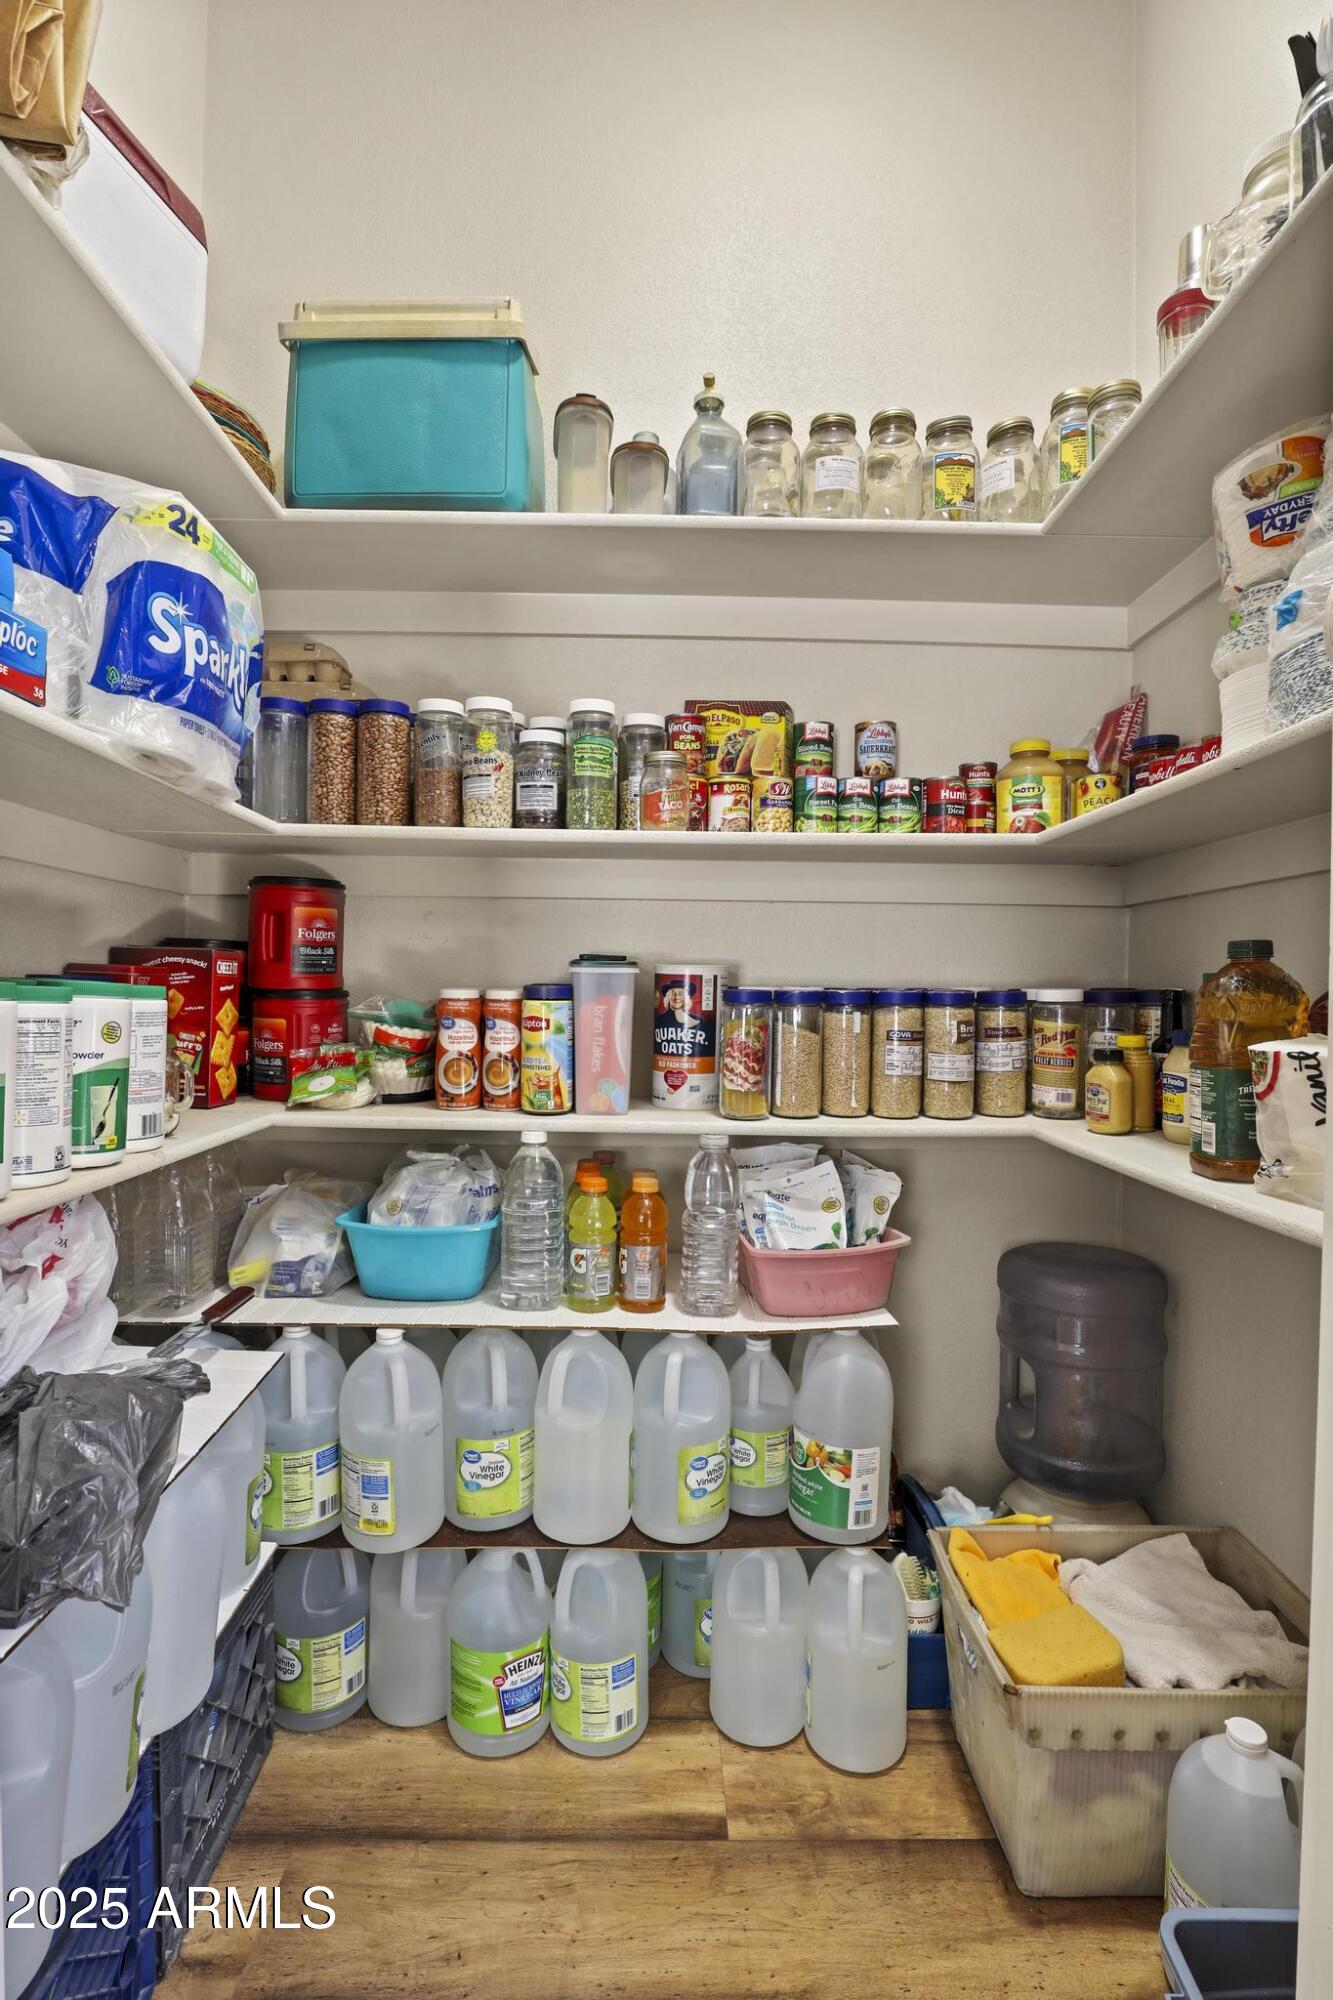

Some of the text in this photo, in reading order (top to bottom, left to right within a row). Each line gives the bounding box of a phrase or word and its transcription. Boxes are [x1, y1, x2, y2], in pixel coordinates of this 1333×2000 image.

[1263, 494, 1313, 519] ERYDAY
[167, 504, 200, 545] 24
[1262, 508, 1313, 534] efty
[148, 597, 250, 711] Sparkl
[33, 687, 44, 698] 38
[1115, 701, 1137, 742] EAUTY
[867, 727, 891, 739] Libby's
[673, 741, 701, 750] BEANS
[658, 800, 684, 810] TACO
[298, 927, 336, 942] Folgers
[299, 946, 335, 955] Black Silk
[162, 955, 208, 969] cheesy snack!
[522, 1020, 548, 1029] Lipton
[592, 1005, 607, 1073] bran flakes
[889, 1031, 912, 1039] GOYA
[1041, 1029, 1076, 1047] Red Mill
[176, 1039, 203, 1051] UFF'D
[253, 1037, 284, 1052] Folgers
[661, 1042, 693, 1055] OATS
[72, 1051, 105, 1060] owder
[479, 1463, 505, 1474] White
[706, 1465, 724, 1478] White
[469, 1471, 505, 1482] Vinegar
[508, 1654, 540, 1677] HEINZ
